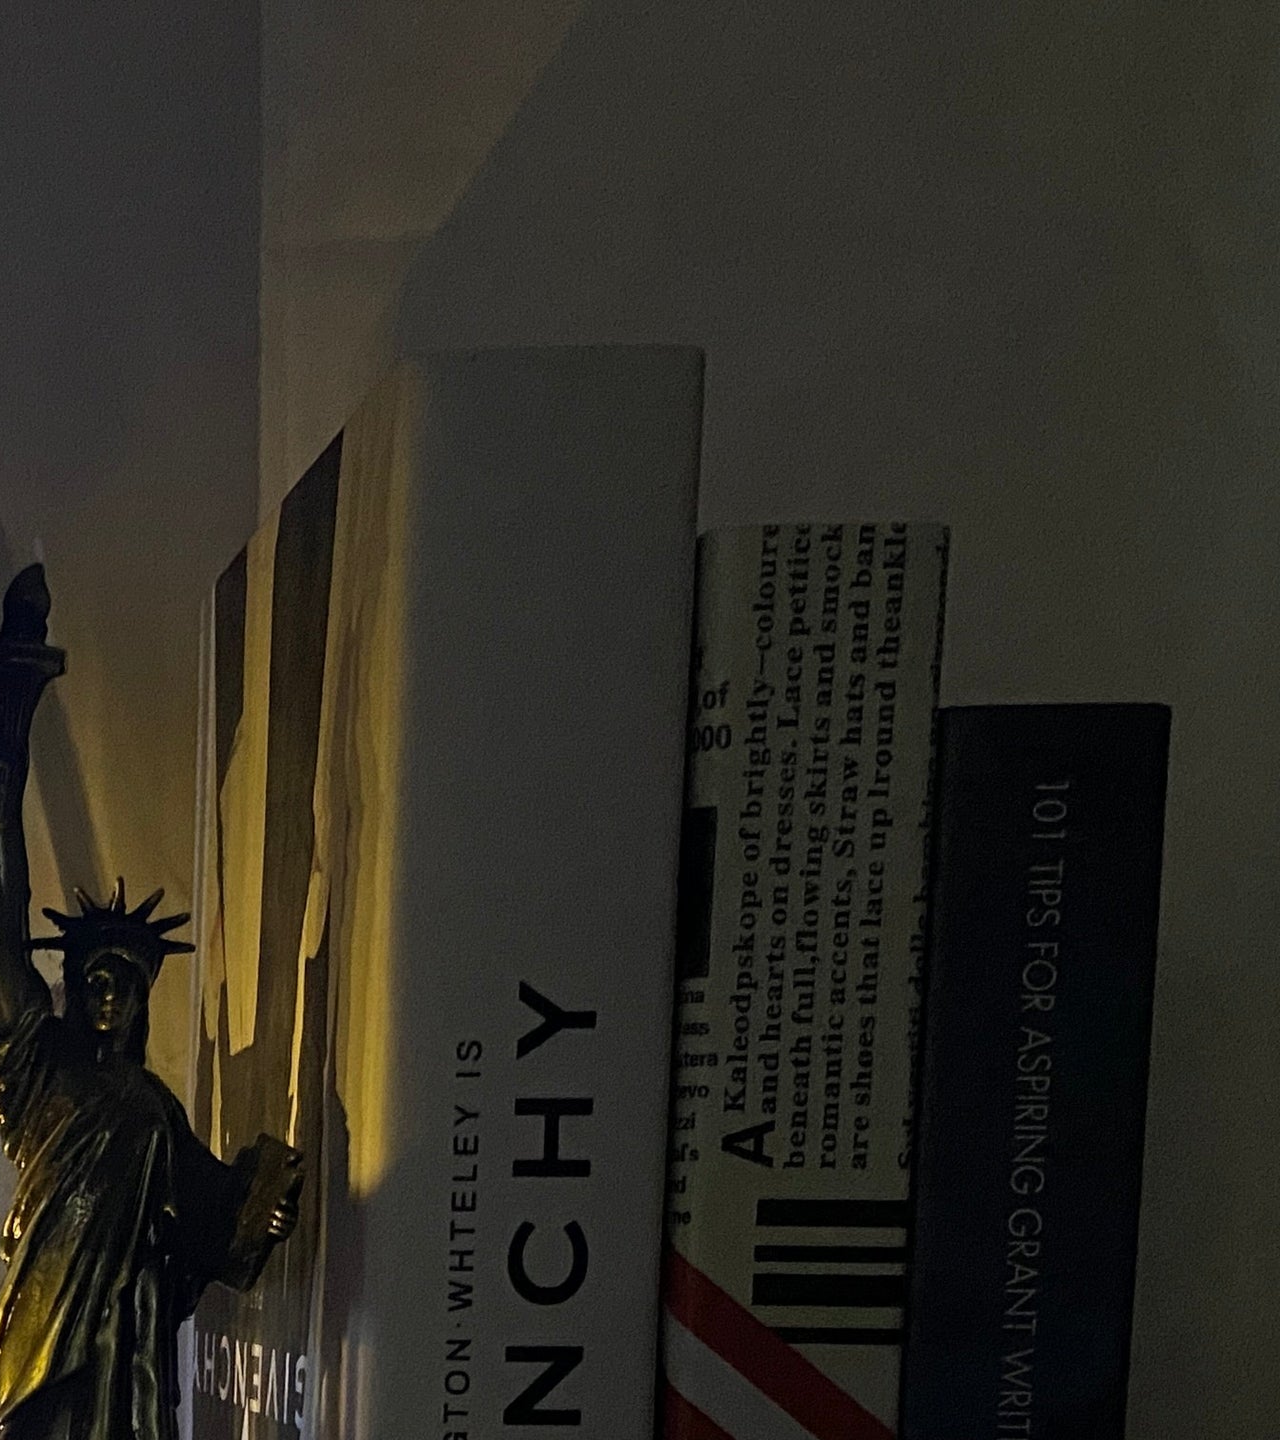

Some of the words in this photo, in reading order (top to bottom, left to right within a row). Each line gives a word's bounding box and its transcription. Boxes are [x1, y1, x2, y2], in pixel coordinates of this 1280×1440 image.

[848, 600, 870, 663] and
[777, 646, 803, 728] Lace
[814, 644, 835, 706] and
[841, 673, 865, 745] hats
[805, 717, 831, 816] skirts
[832, 756, 859, 858] Straw
[870, 807, 892, 849] up
[1032, 781, 1070, 839] 101
[739, 826, 762, 862] of
[771, 884, 789, 926] on
[860, 860, 884, 926] lace
[1024, 859, 1064, 928] TIPS
[759, 935, 786, 1041] hearts
[856, 936, 880, 1004] that
[1020, 942, 1059, 1012] FOR
[455, 1038, 484, 1080] IS
[758, 1053, 780, 1115] and
[820, 1015, 844, 1169] romantic
[850, 1015, 875, 1106] shoes
[783, 1035, 811, 1169] beneath
[1008, 1024, 1053, 1197] ASPIRING
[721, 1120, 775, 1168] A
[851, 1115, 870, 1169] are
[1001, 1206, 1043, 1337] GRANT
